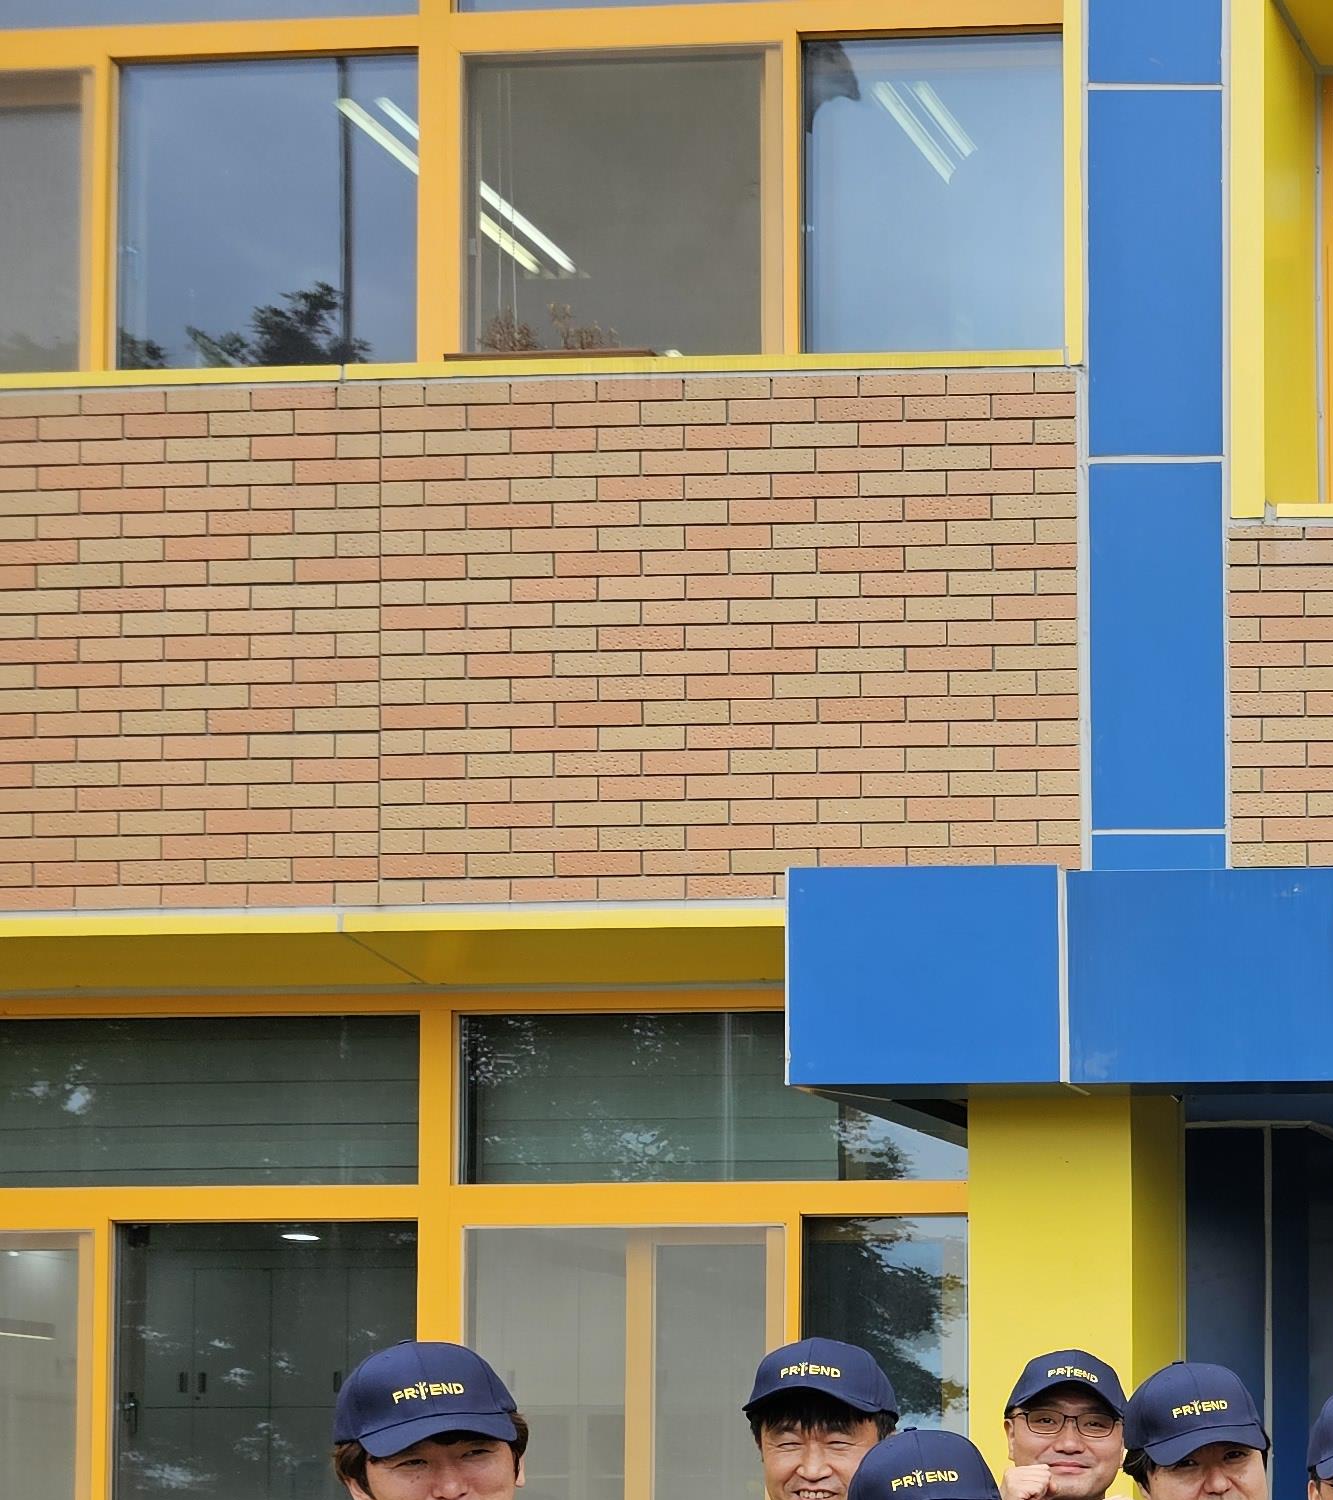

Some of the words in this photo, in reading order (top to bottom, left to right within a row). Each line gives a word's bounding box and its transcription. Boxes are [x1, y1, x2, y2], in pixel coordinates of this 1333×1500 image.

[780, 1361, 841, 1379] FRIEND
[1046, 1364, 1099, 1385] FRIEND
[392, 1381, 465, 1405] FRIEND
[1171, 1399, 1228, 1419] FRIEND
[891, 1469, 959, 1492] FRIEND
